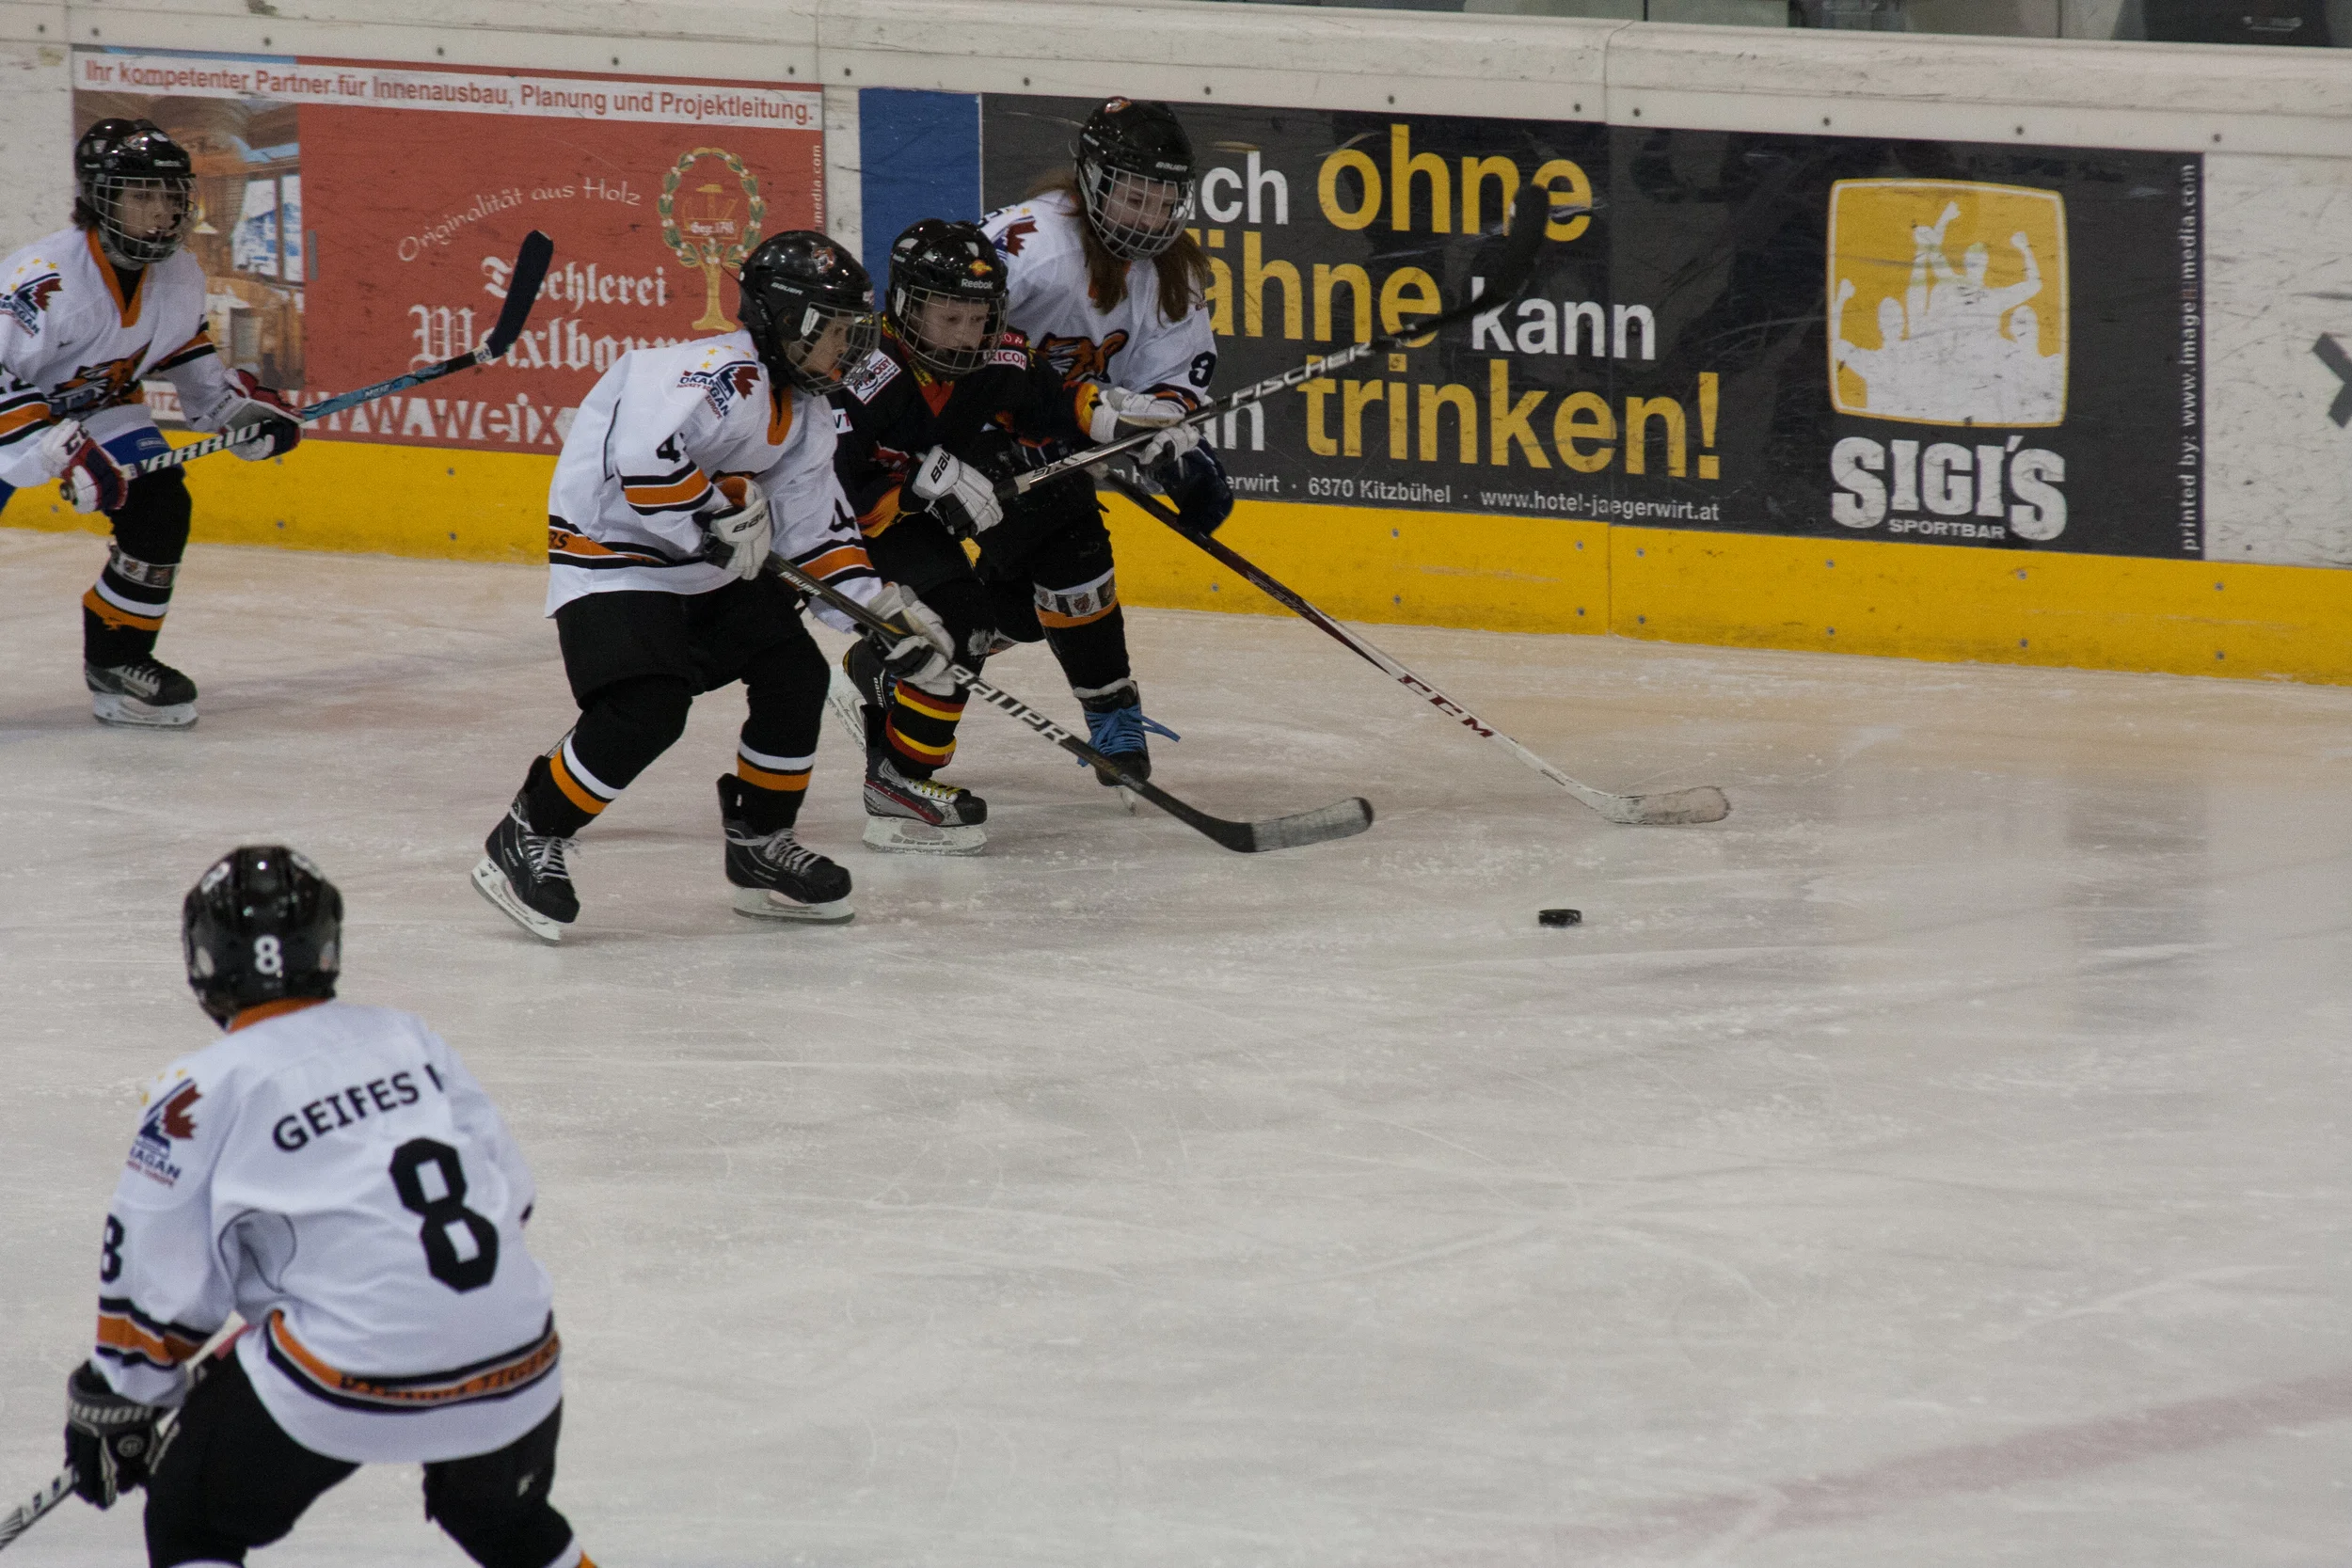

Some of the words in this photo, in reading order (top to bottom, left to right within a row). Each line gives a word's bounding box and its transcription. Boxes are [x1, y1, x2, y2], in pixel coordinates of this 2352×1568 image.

[86, 59, 112, 82] Ihr
[119, 61, 247, 91] kompetenter
[255, 70, 330, 94] Partner
[338, 74, 366, 97] für
[373, 76, 514, 107] Innenausbau,
[520, 84, 606, 115] Planung
[613, 90, 653, 113] und
[660, 91, 814, 125] Projektleitung.
[397, 187, 523, 262] Originalität
[531, 185, 576, 200] aus
[583, 177, 642, 206] Holz
[1318, 123, 1593, 242] ohne
[961, 277, 993, 290] Reebok
[1471, 276, 1657, 361] kann
[1295, 353, 1721, 480] trinken!
[2178, 436, 2200, 465] by:
[1309, 476, 1355, 499] 6370
[1360, 478, 1451, 504] Kitzbühel
[1481, 487, 1720, 522] www.hotel-jaegerwirt.at
[1888, 518, 2006, 539] SPORTBAR
[2178, 474, 2200, 551] printed
[946, 662, 1074, 744] BAUER
[1397, 672, 1496, 739] CCM
[255, 934, 282, 975] 8
[272, 1070, 420, 1153] GEIFES
[390, 1137, 499, 1293] 8
